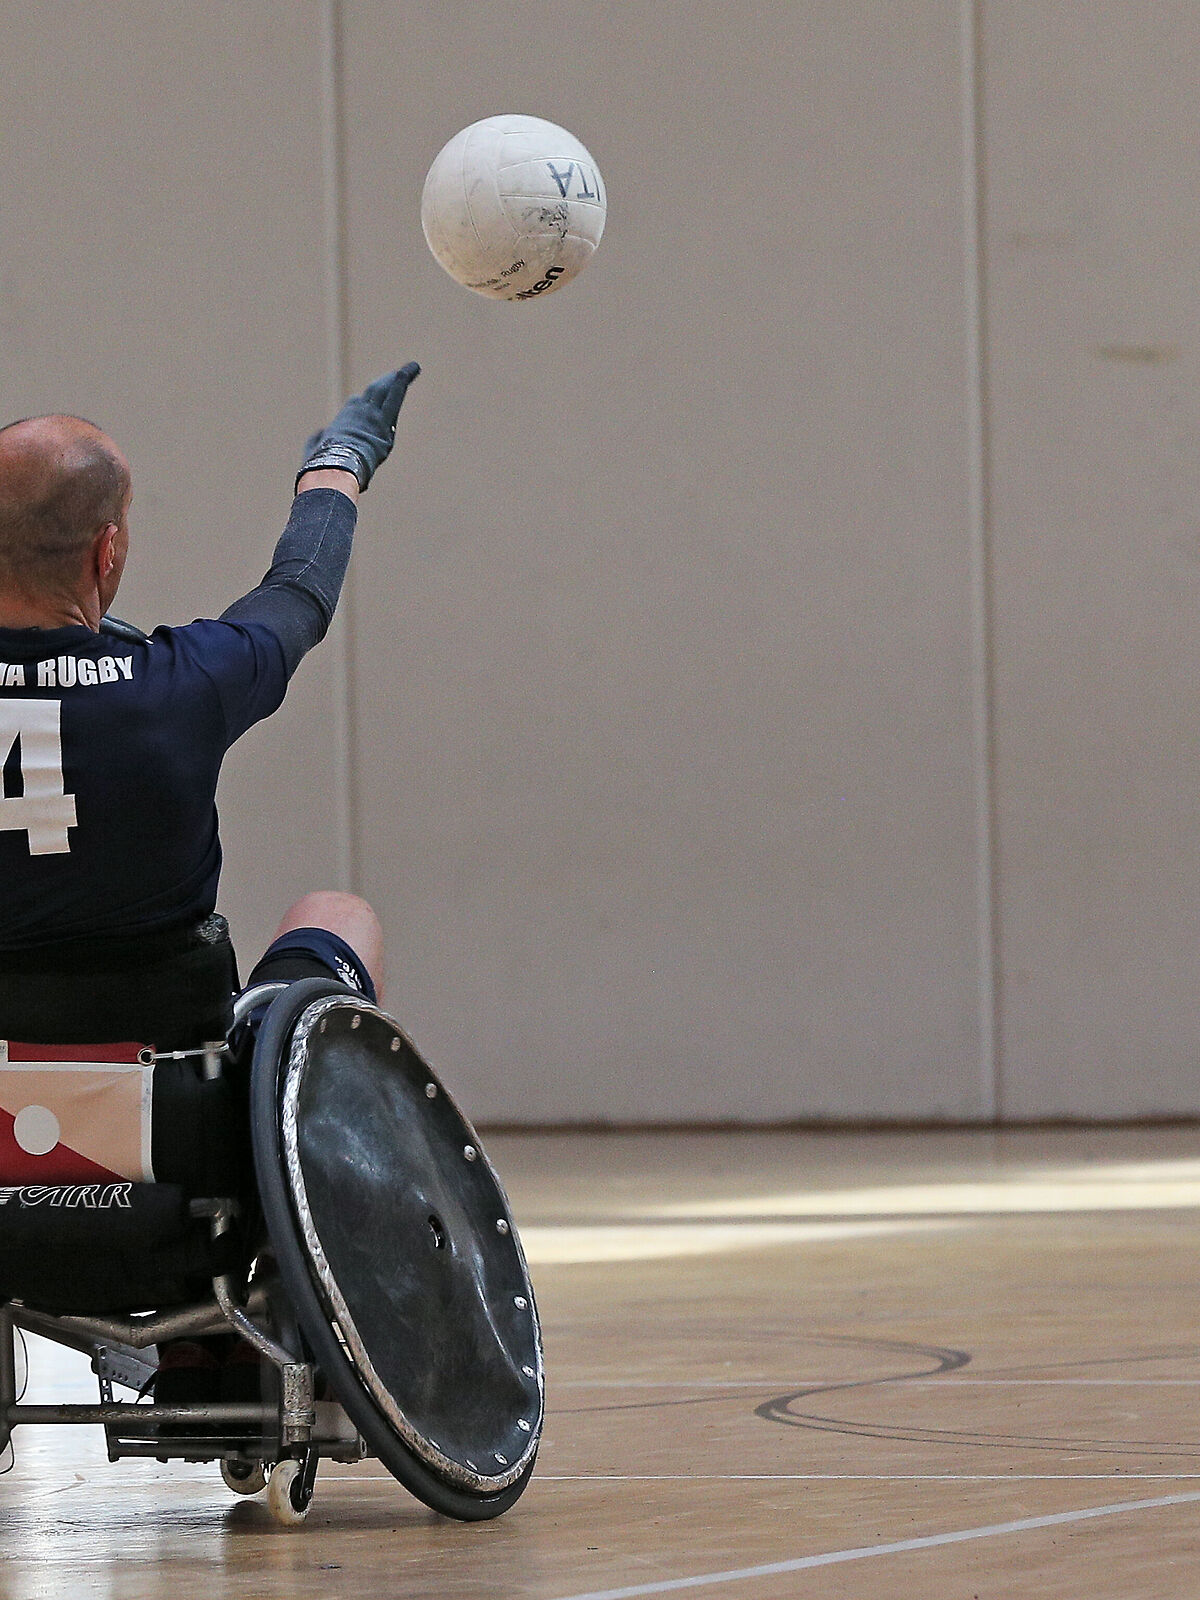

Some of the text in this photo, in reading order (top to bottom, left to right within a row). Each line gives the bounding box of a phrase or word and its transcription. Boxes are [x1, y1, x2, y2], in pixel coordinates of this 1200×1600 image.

[546, 162, 601, 202] ITA
[500, 258, 526, 278] Rugby
[37, 655, 134, 687] RUGBY
